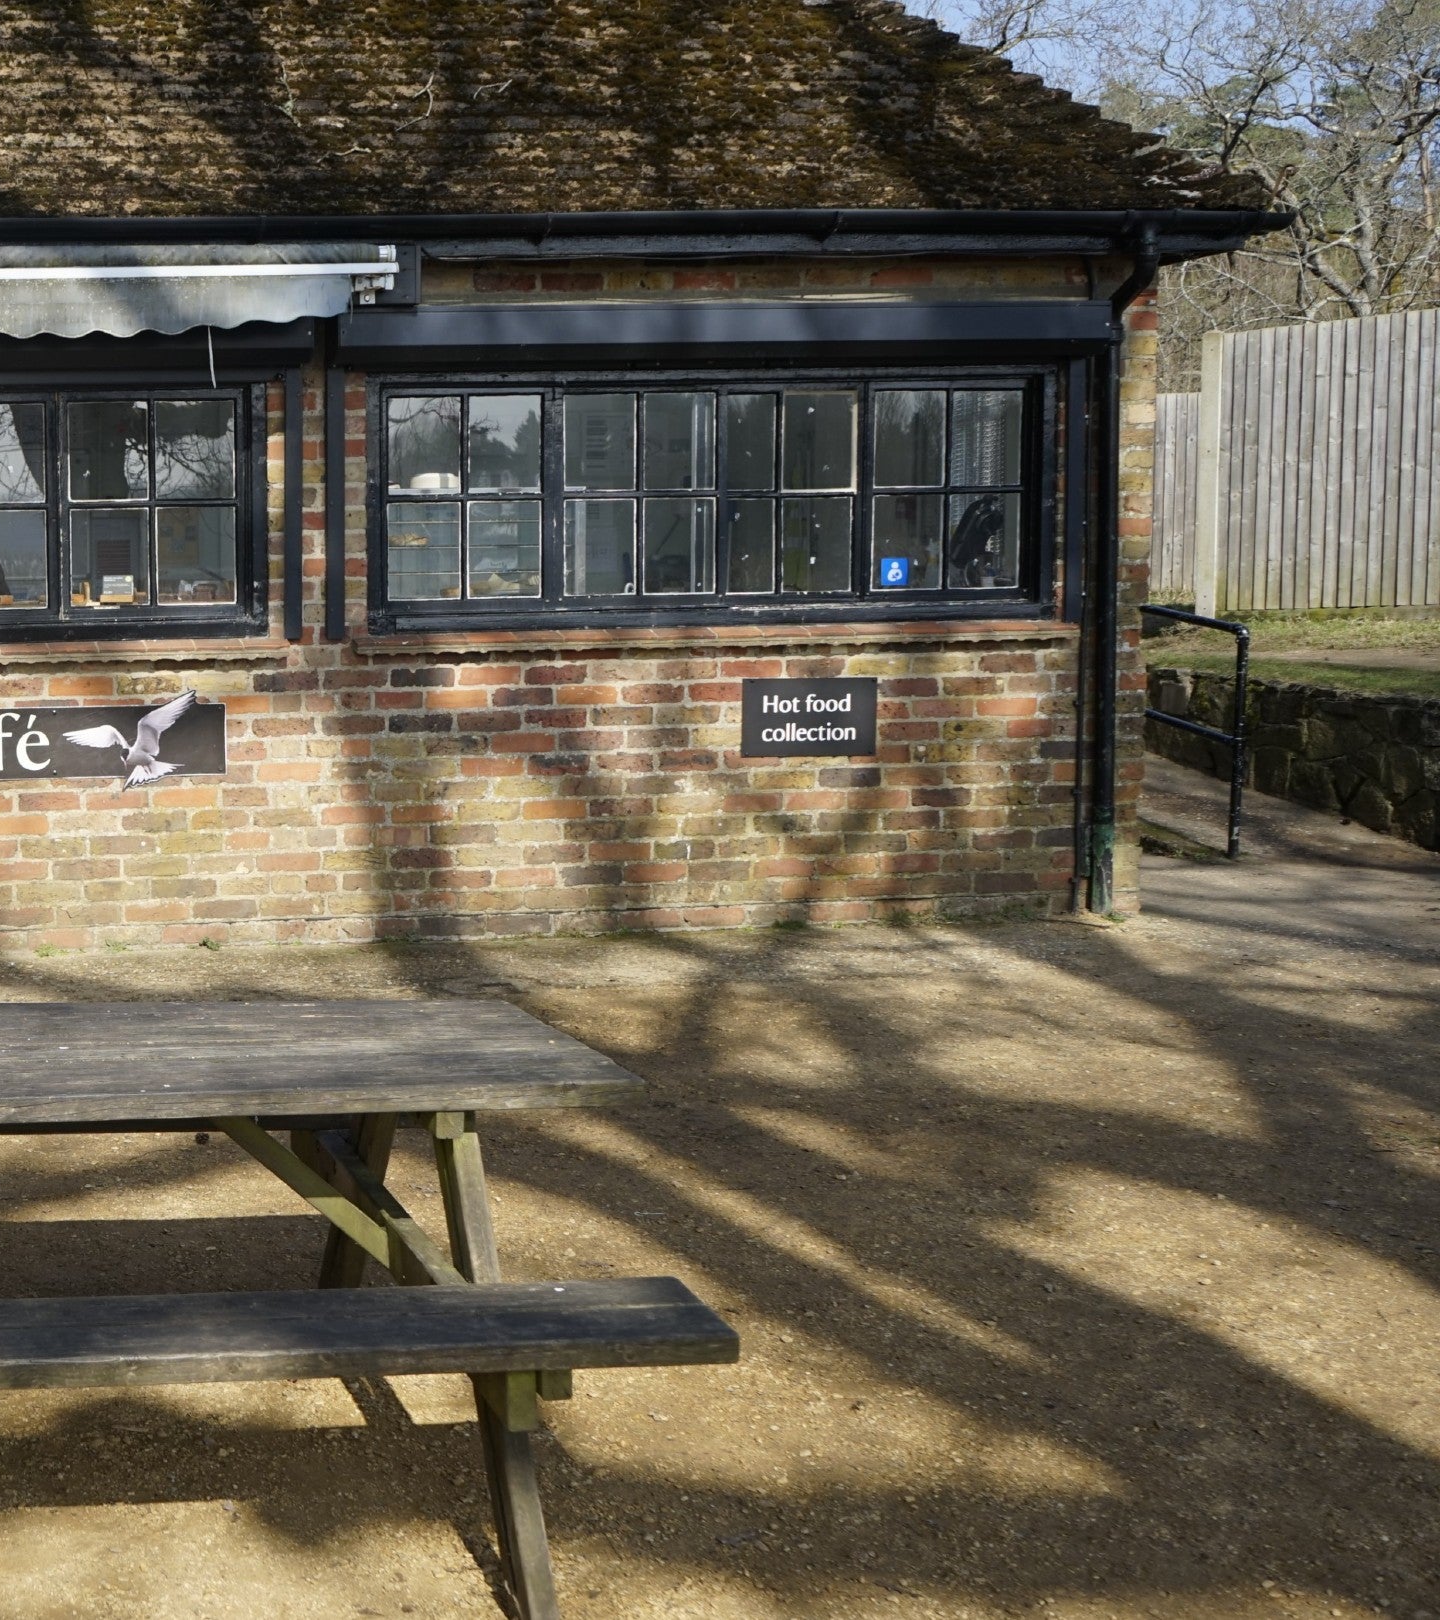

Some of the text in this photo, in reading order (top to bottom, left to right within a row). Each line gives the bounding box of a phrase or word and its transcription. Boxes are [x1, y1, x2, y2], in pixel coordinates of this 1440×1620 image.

[762, 693, 851, 713] Hot food
[761, 722, 856, 741] collection
